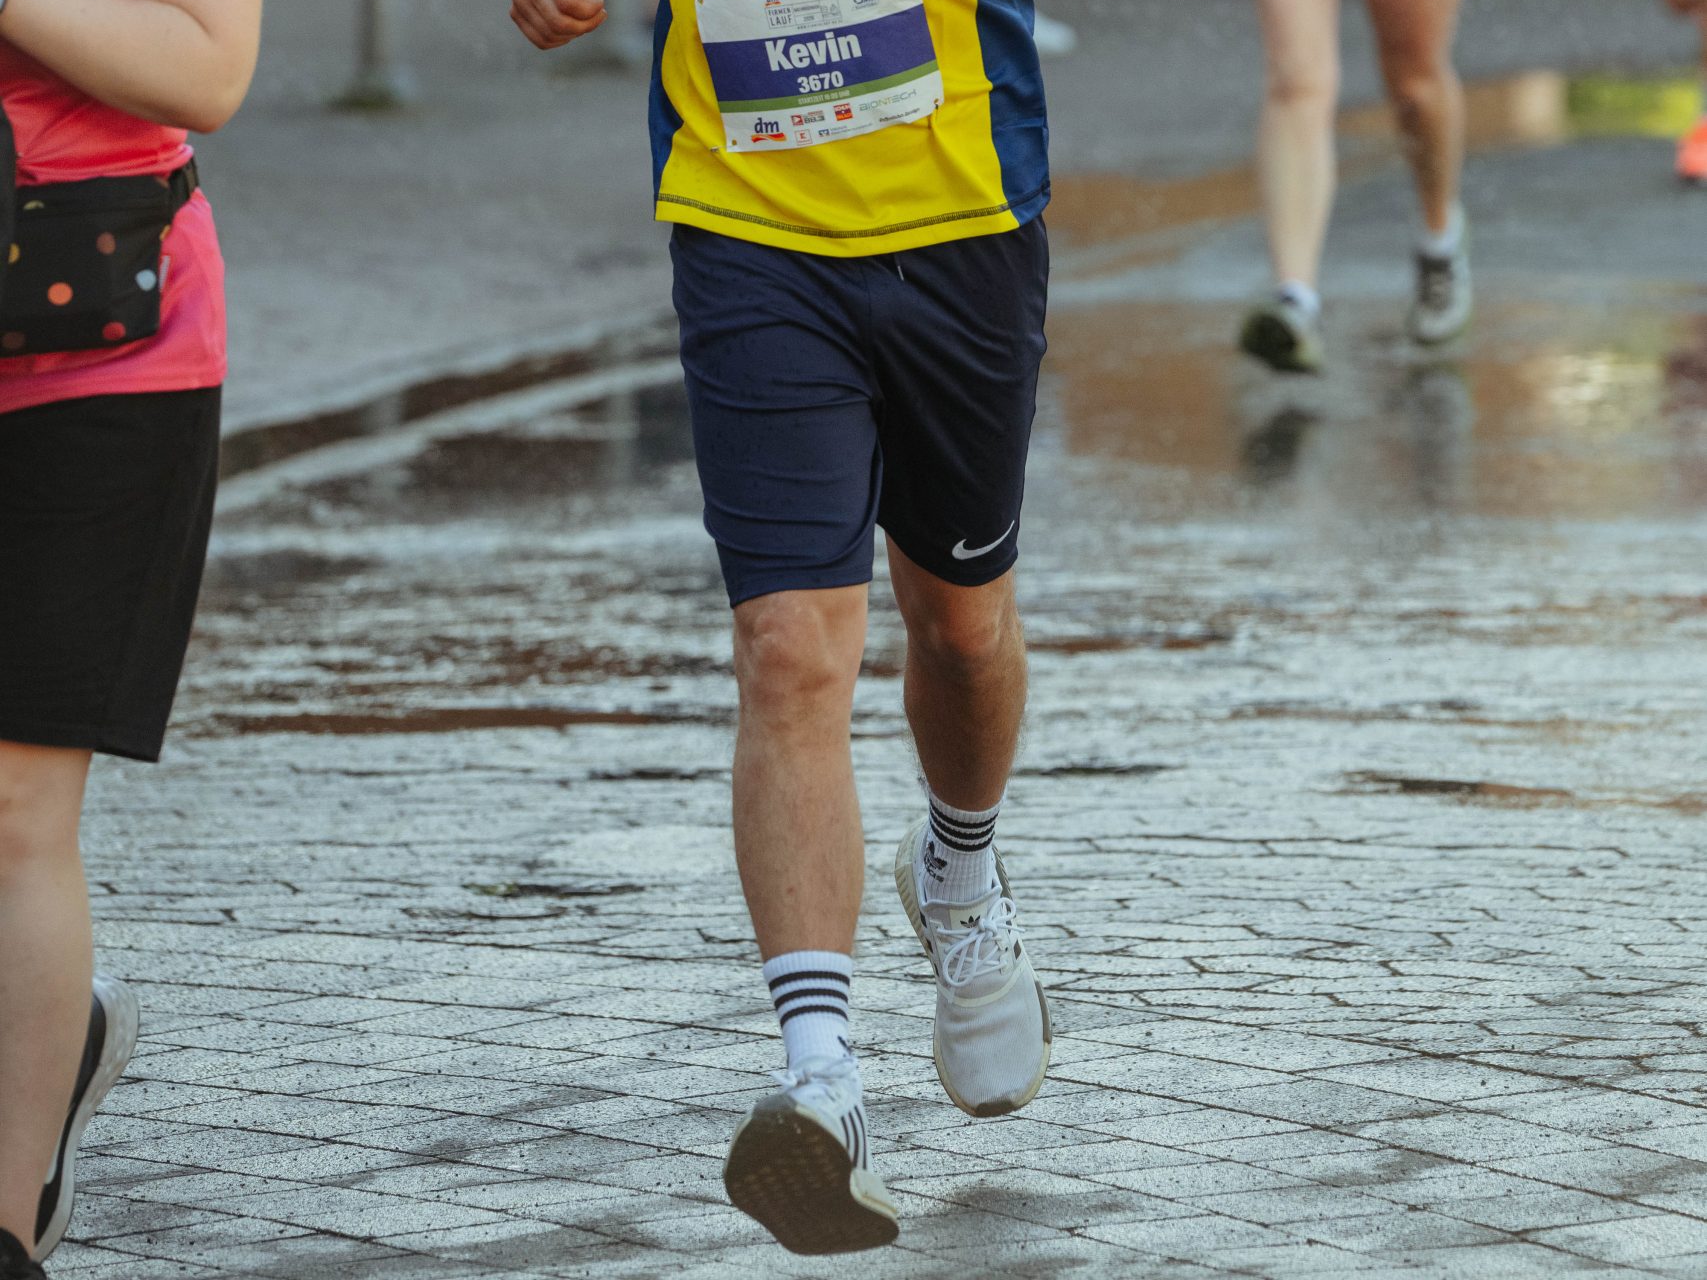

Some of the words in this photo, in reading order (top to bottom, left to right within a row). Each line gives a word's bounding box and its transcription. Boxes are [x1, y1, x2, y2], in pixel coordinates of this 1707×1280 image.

[767, 6, 792, 17] FIRMEN
[770, 15, 793, 27] LAUF
[764, 31, 863, 72] Kevin
[796, 70, 845, 94] 3670
[753, 116, 780, 134] dm
